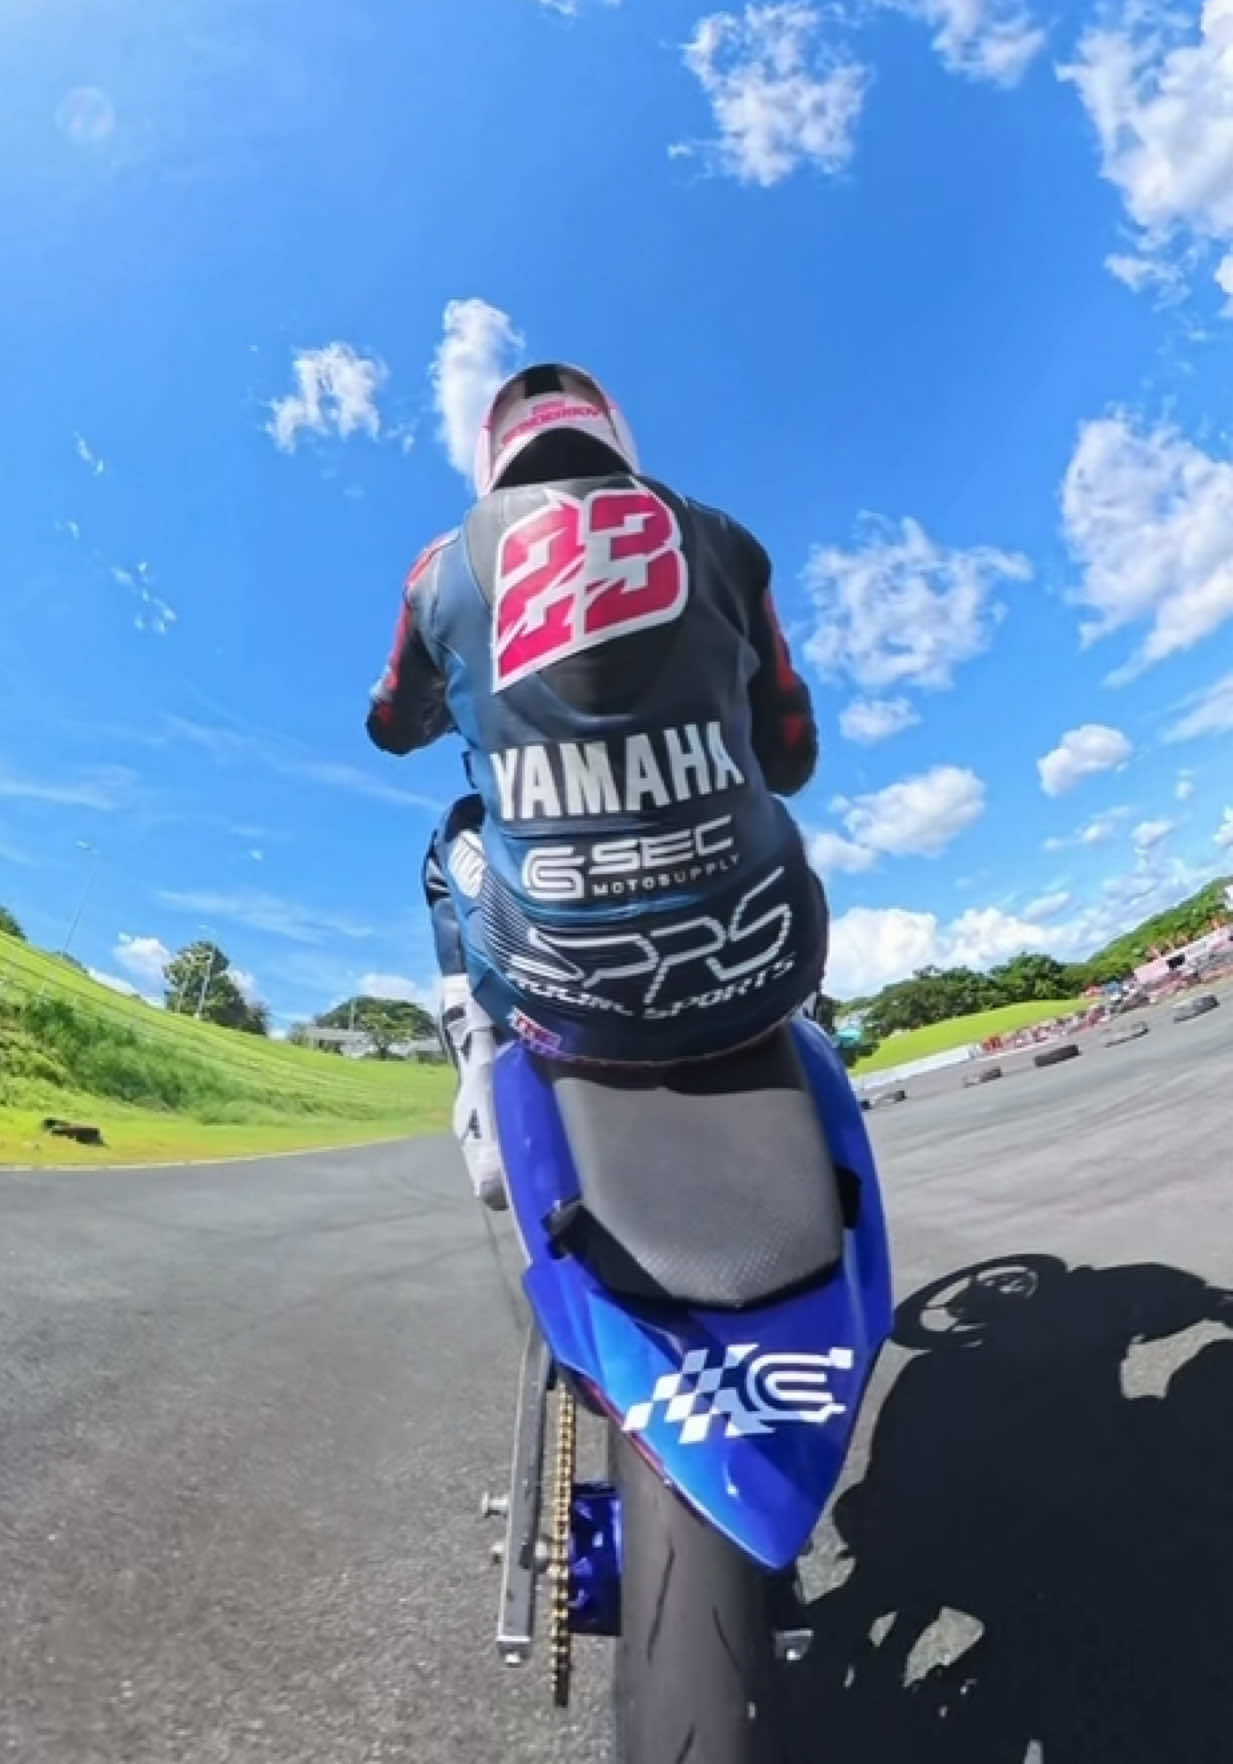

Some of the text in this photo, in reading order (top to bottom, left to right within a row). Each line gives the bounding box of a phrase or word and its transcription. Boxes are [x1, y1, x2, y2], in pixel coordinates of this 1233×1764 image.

[493, 488, 689, 695] 23
[490, 721, 745, 821] YAMAHA
[592, 853, 740, 897] MOTOSUPPLY
